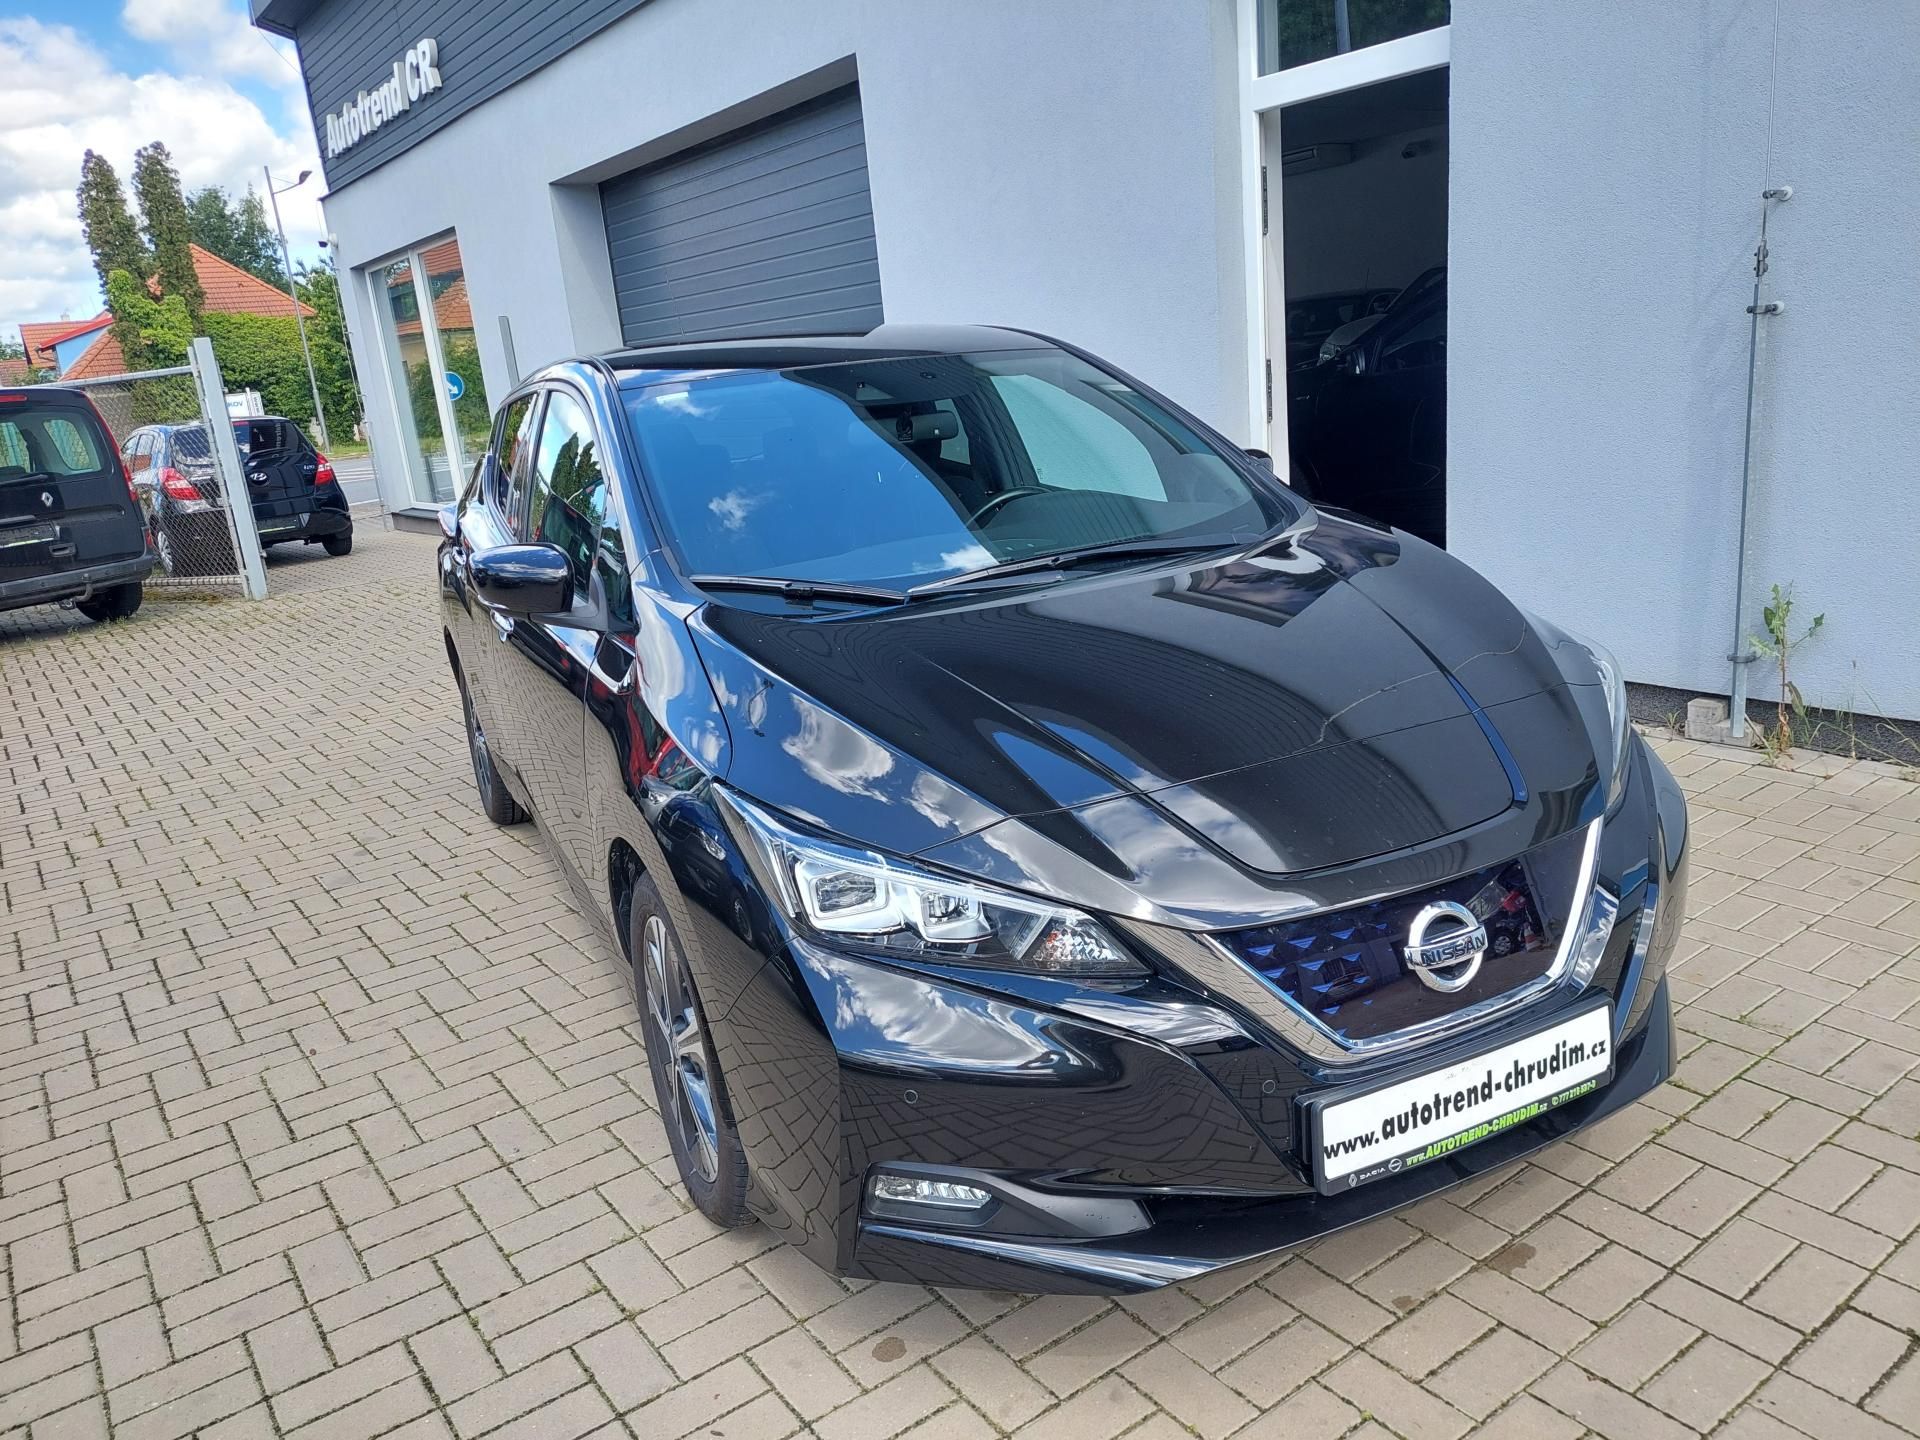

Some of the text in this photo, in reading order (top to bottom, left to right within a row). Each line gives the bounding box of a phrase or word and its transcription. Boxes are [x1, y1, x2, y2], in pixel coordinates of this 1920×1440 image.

[326, 38, 443, 159] Autotrend CR
[1420, 934, 1486, 967] NISSAN
[1323, 1039, 1606, 1159] www.autotrend-chrudim.cz
[1360, 1167, 1386, 1180] DACIA
[1406, 1102, 1548, 1166] www.AUTOTREND-CHRUDIM.cz
